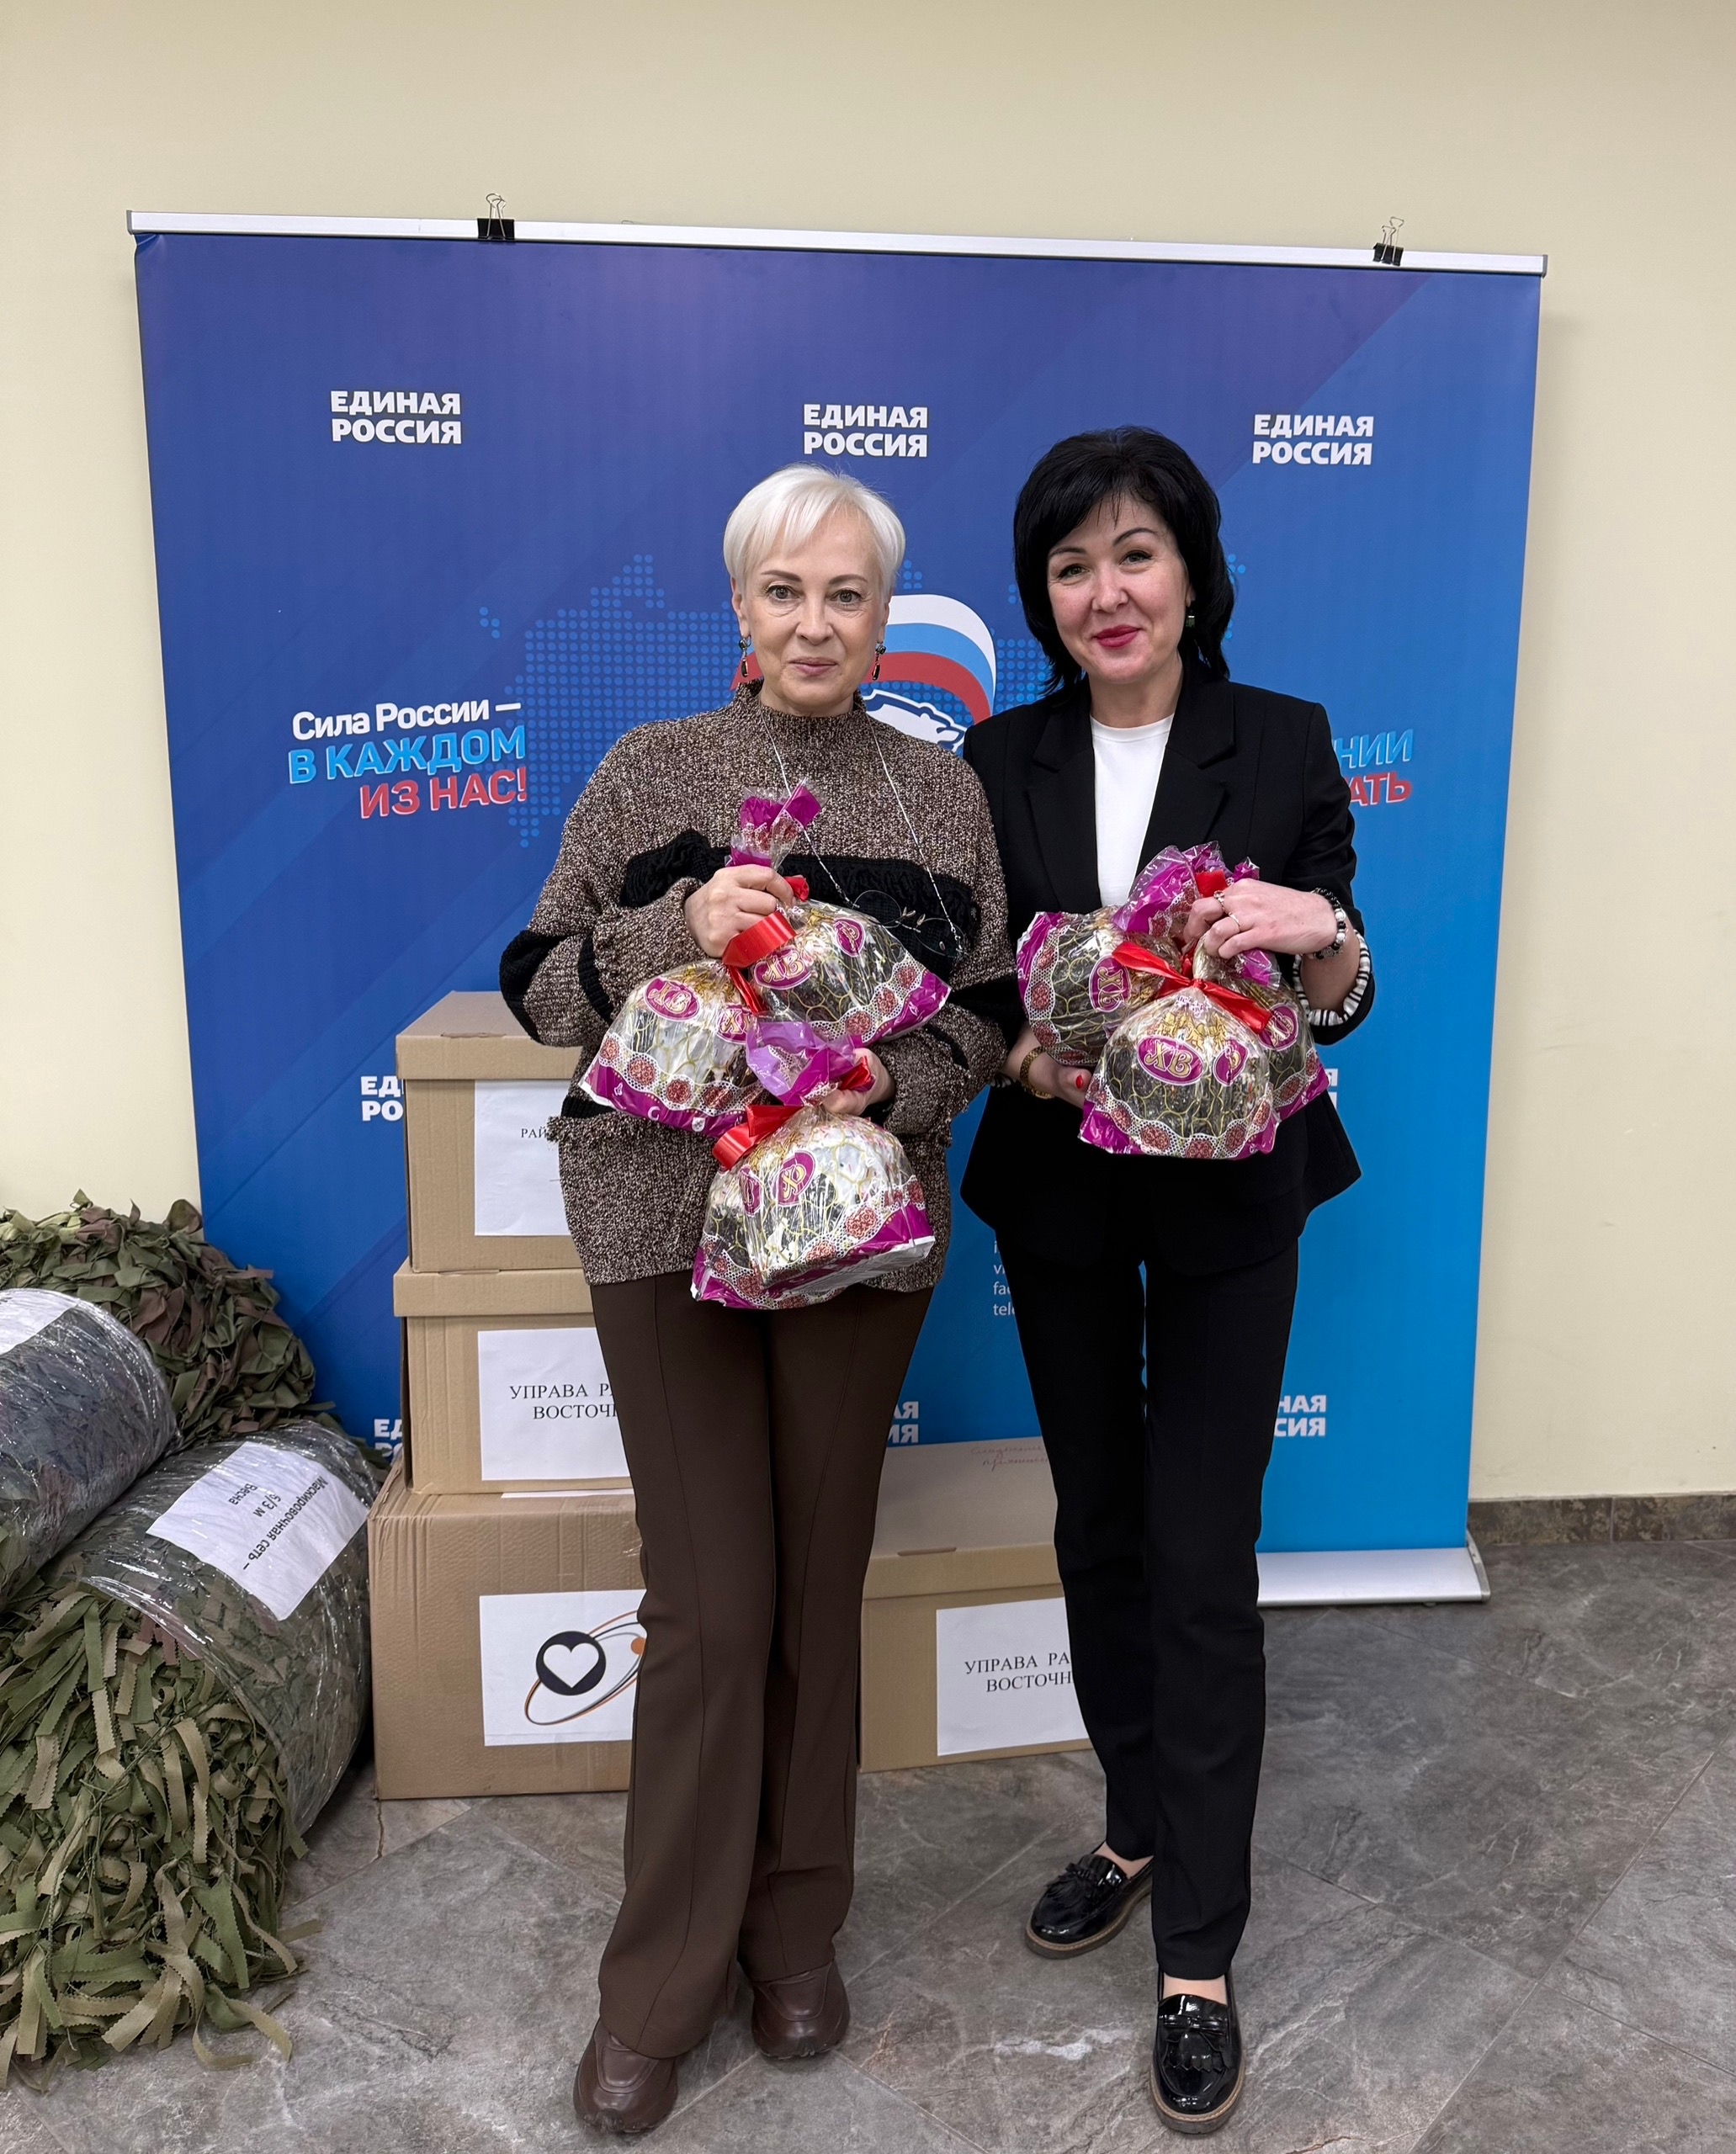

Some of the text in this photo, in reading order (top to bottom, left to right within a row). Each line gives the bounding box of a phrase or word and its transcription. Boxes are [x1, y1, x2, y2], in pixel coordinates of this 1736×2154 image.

[330, 390, 462, 416] ЕДИНАЯ
[802, 404, 929, 429] ЕДИНАЯ
[1253, 414, 1375, 438] ЕДИНАЯ
[331, 418, 462, 444] РОССИЯ
[802, 431, 929, 458] РОССИЯ
[1251, 441, 1373, 465] РОССИЯ
[292, 707, 370, 740] Сила
[376, 699, 490, 732] России
[288, 724, 527, 784] В КАЖДОМ
[359, 766, 528, 820] ИЗ НАС!
[1345, 771, 1413, 807] АТЬ
[1144, 1039, 1193, 1079] ХВ
[360, 1075, 404, 1098] ЕД
[509, 1382, 613, 1399] УПРАВА Р
[1274, 1417, 1326, 1437] СИЯ
[228, 1483, 258, 1505] Весна
[267, 1476, 329, 1541] Маскировочная
[247, 1540, 271, 1561] сеть
[964, 1654, 1038, 1674] УПРАВА
[985, 1670, 1072, 1693] ВОСТОЧН
